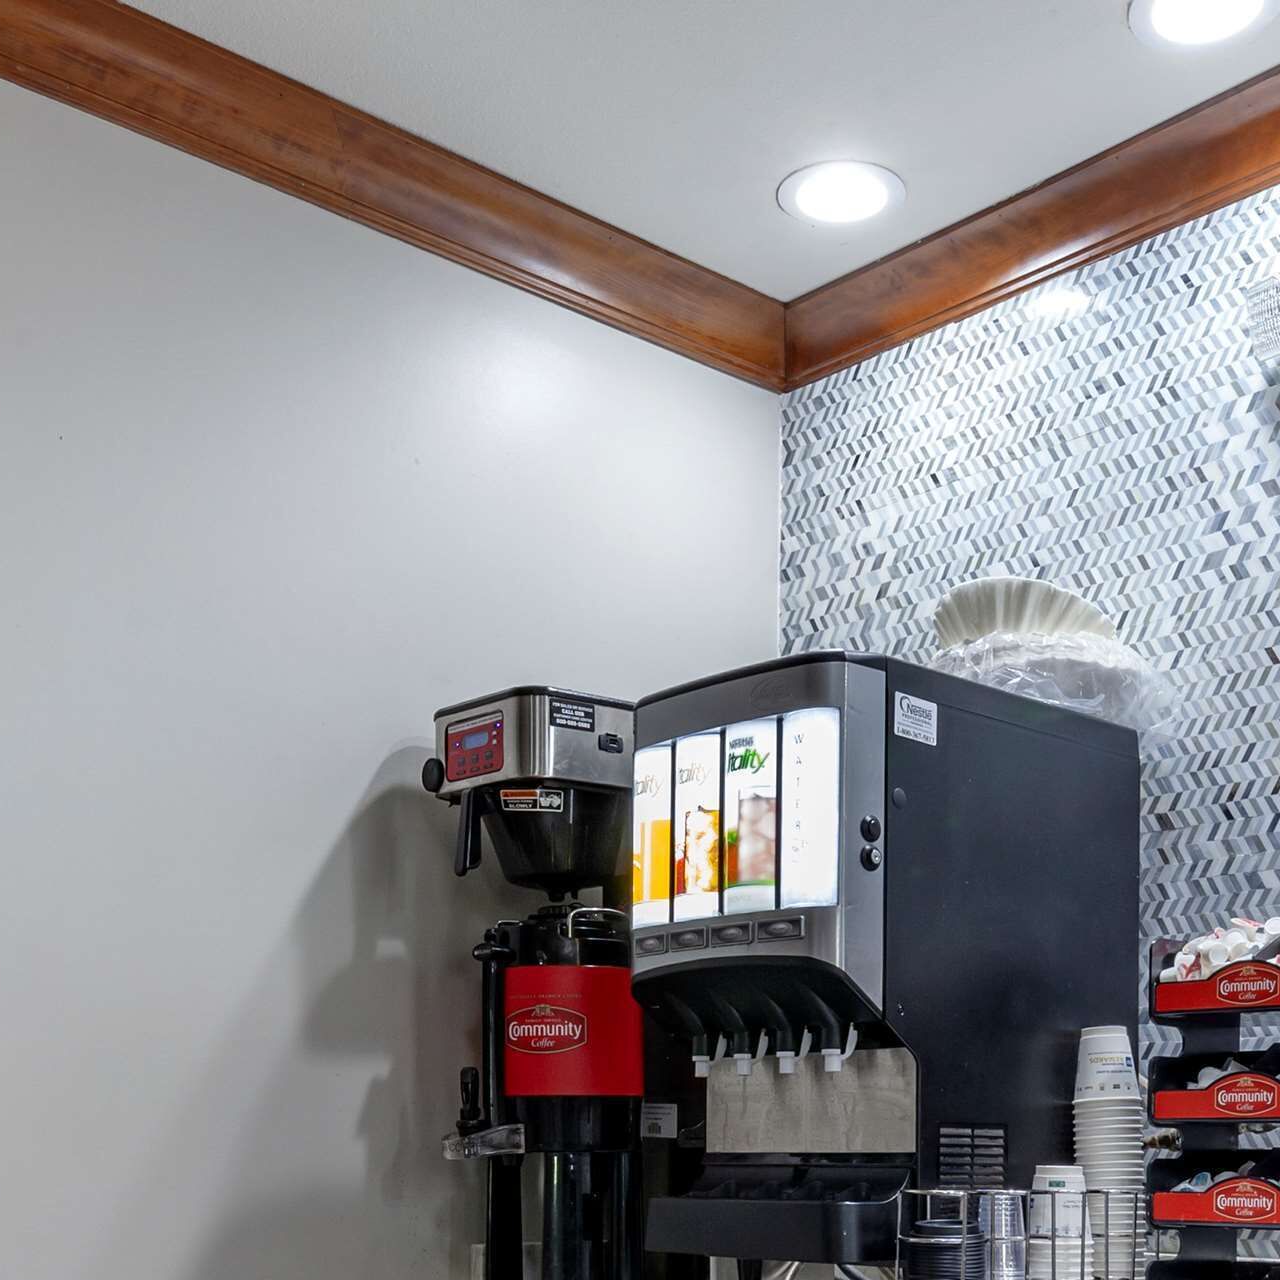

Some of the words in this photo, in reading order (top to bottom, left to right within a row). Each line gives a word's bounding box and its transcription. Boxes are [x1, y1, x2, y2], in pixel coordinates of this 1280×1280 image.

[1220, 978, 1276, 995] Community
[508, 1020, 582, 1041] Community
[531, 1038, 556, 1048] Coffee
[1218, 1089, 1274, 1106] Community
[1217, 1194, 1273, 1211] Community
